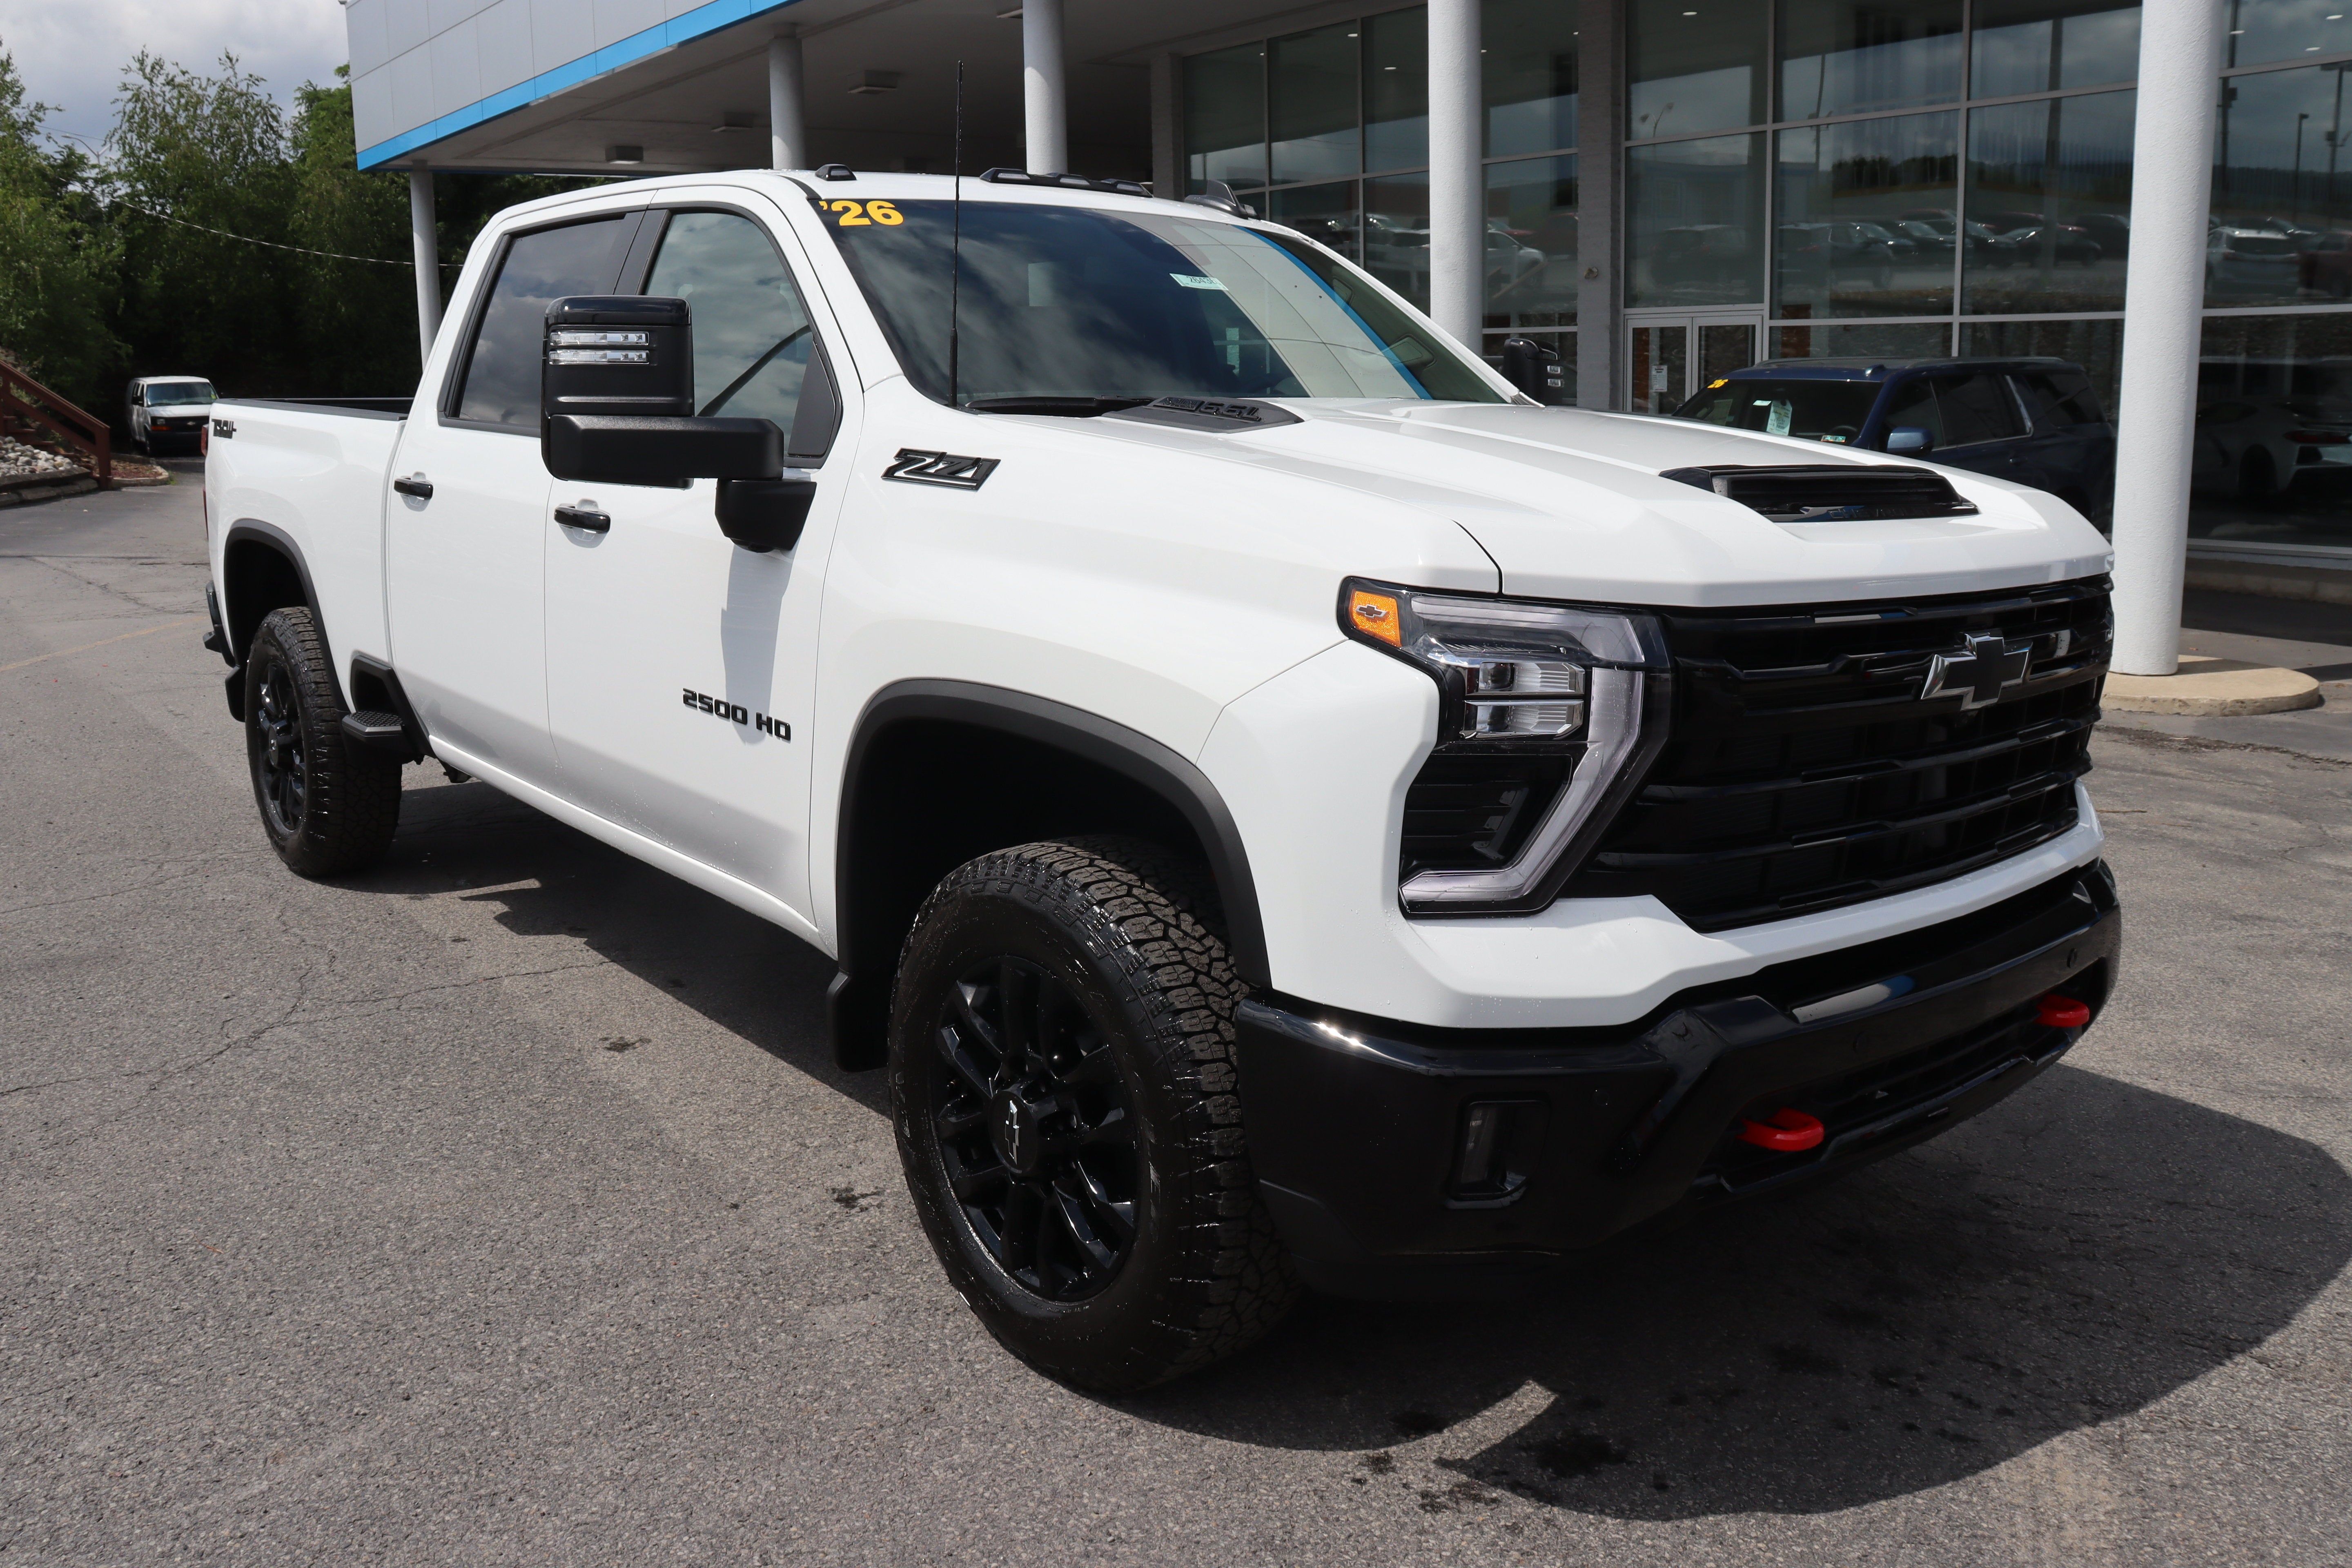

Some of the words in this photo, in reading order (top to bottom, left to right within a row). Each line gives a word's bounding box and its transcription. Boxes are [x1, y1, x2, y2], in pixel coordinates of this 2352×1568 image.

[880, 447, 1001, 491] Z71
[682, 687, 748, 725] 2500
[755, 712, 791, 741] HD
